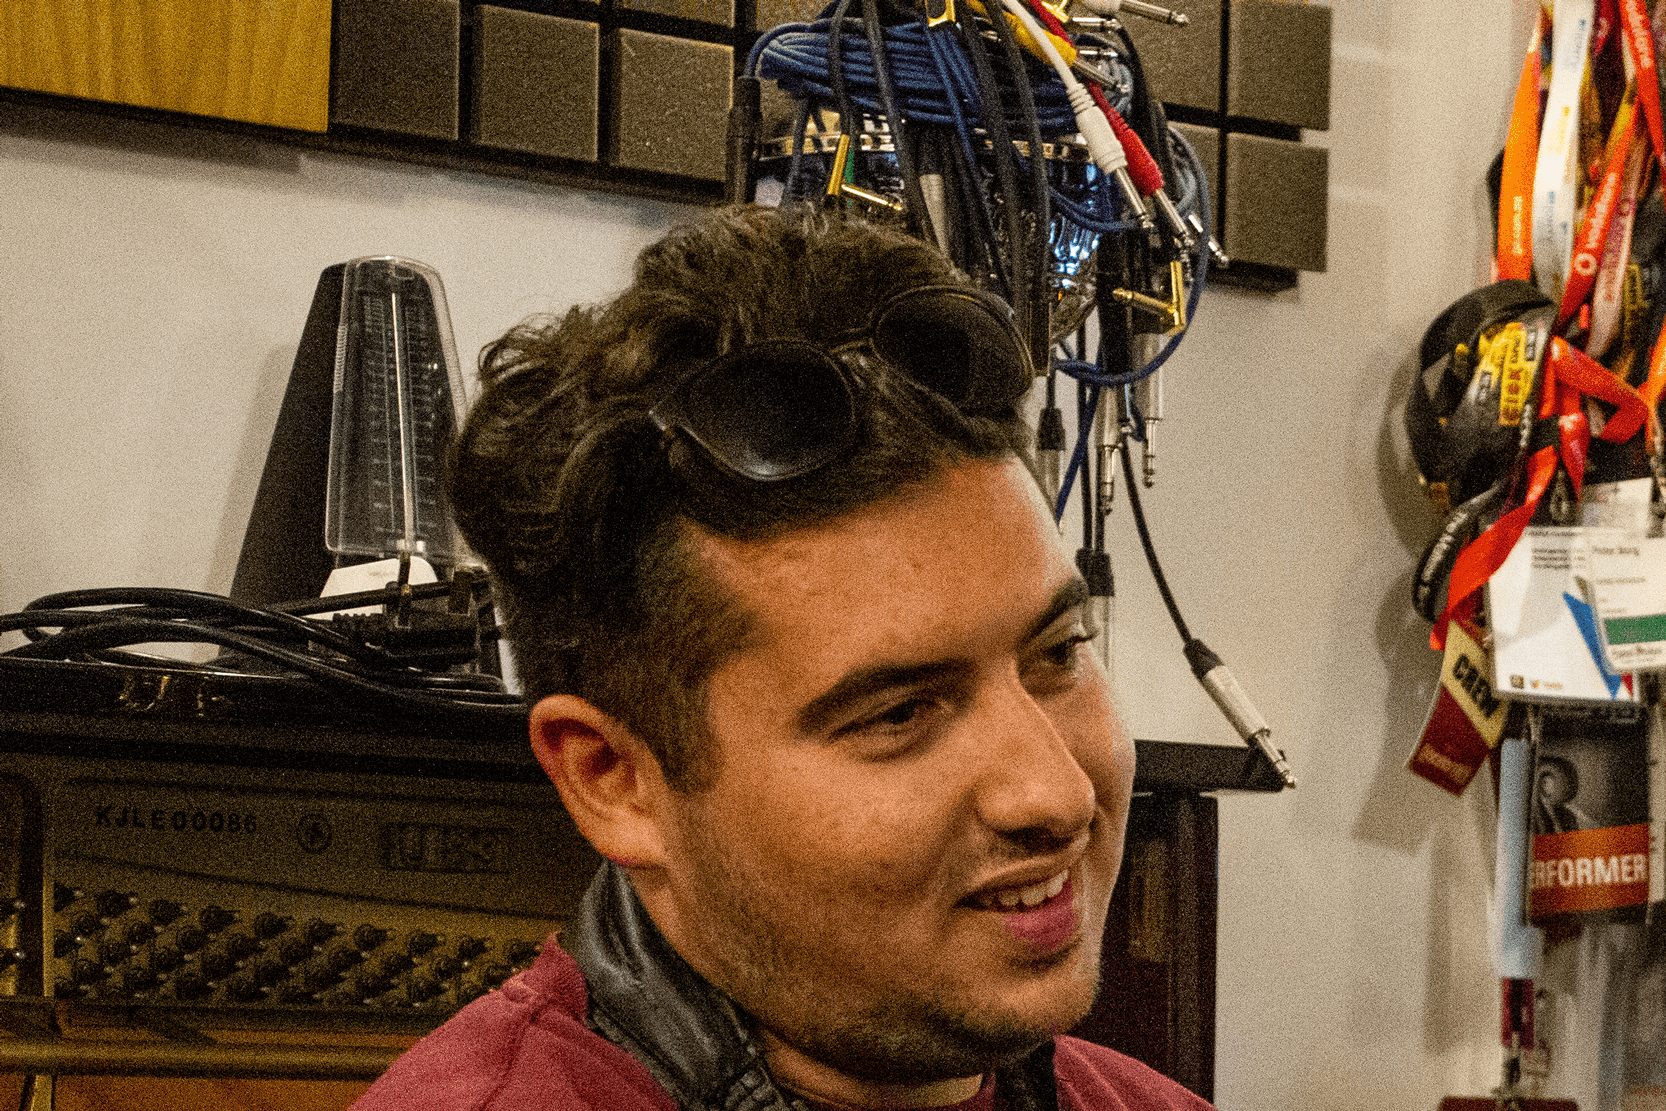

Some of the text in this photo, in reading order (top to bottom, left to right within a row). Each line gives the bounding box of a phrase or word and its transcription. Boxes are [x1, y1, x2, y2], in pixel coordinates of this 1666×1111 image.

[1587, 173, 1617, 248] vodafone
[1451, 653, 1502, 719] CREW
[95, 805, 258, 833] KJLE00086
[1532, 853, 1646, 888] RFORMER
